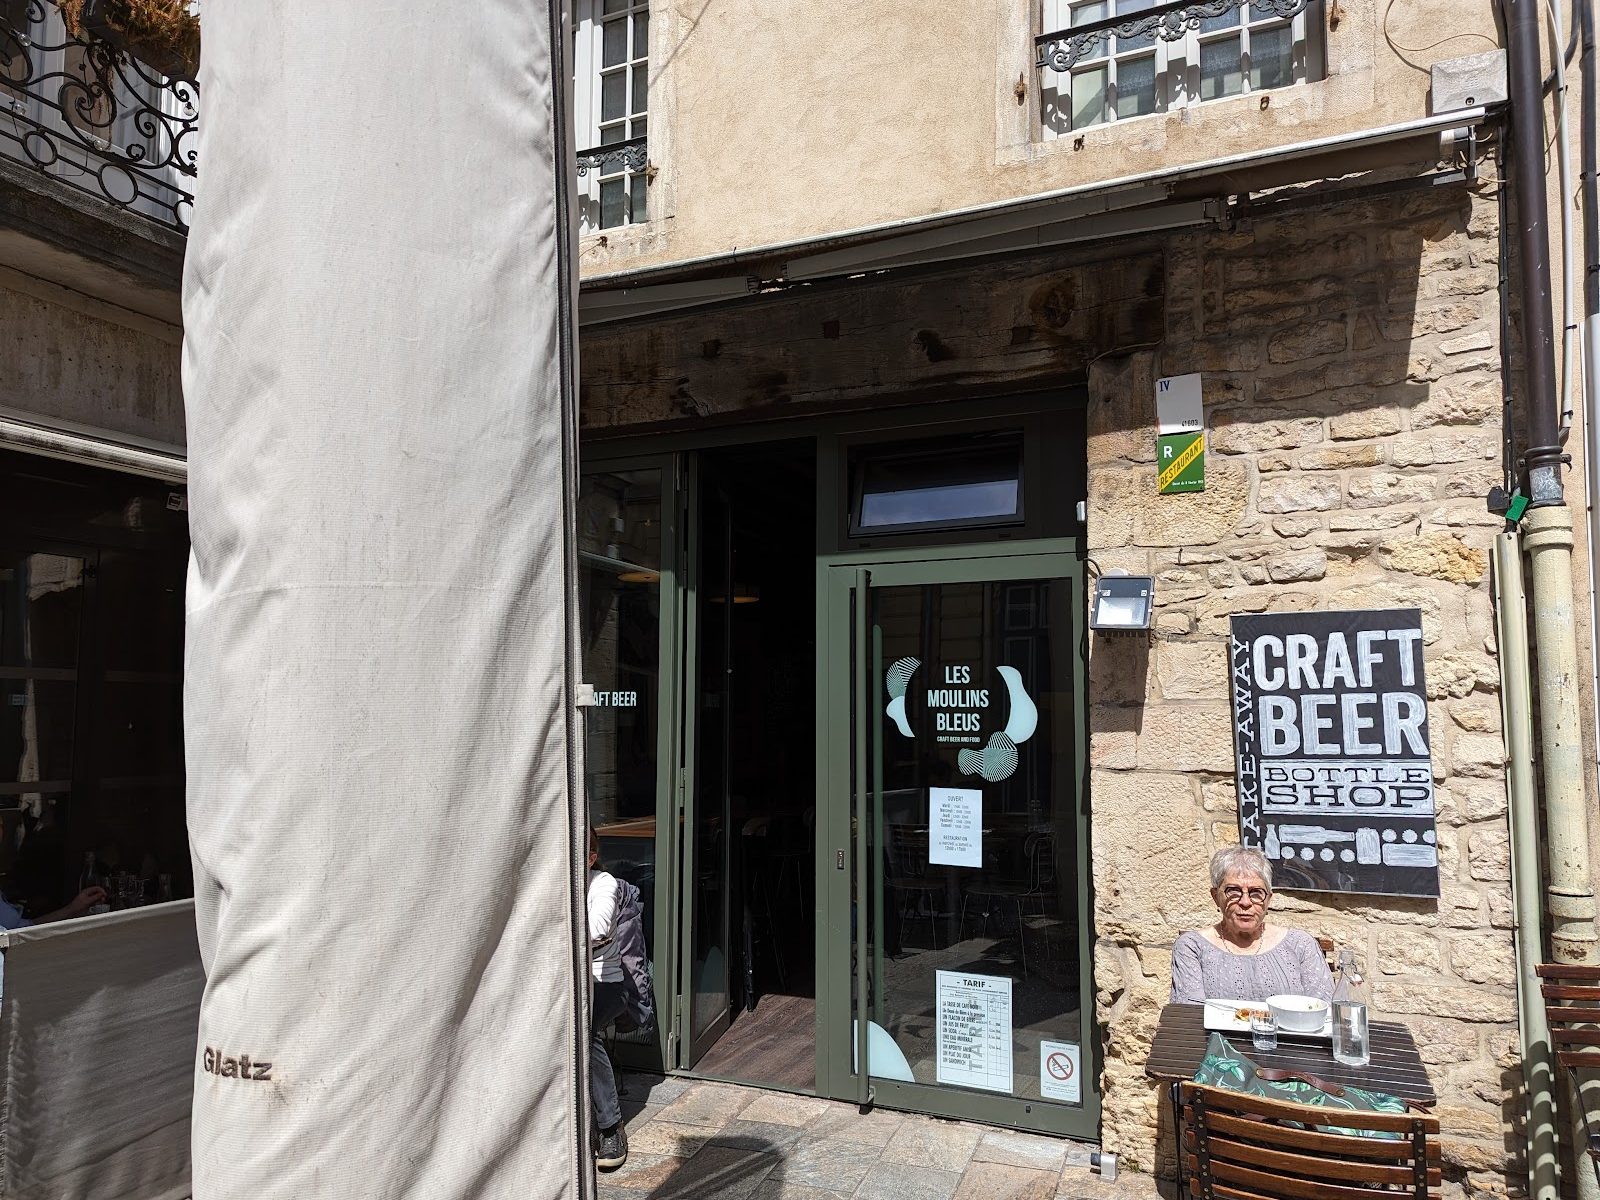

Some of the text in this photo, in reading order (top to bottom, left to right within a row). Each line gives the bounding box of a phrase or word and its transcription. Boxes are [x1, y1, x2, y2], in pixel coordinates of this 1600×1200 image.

[1160, 380, 1170, 392] IV
[1164, 446, 1172, 458] R
[1160, 438, 1203, 486] RESTAURANT
[1252, 629, 1421, 691] CRAFT
[946, 666, 970, 684] LES
[594, 692, 636, 706] AFT BEER
[928, 690, 989, 708] MOULINS
[937, 713, 980, 731] BLEUS
[1258, 692, 1430, 756] BEER
[1264, 767, 1430, 783] BOTTLE
[1266, 784, 1430, 808] SHOP
[963, 979, 986, 988] TARIF
[204, 1046, 272, 1080] Glatz
